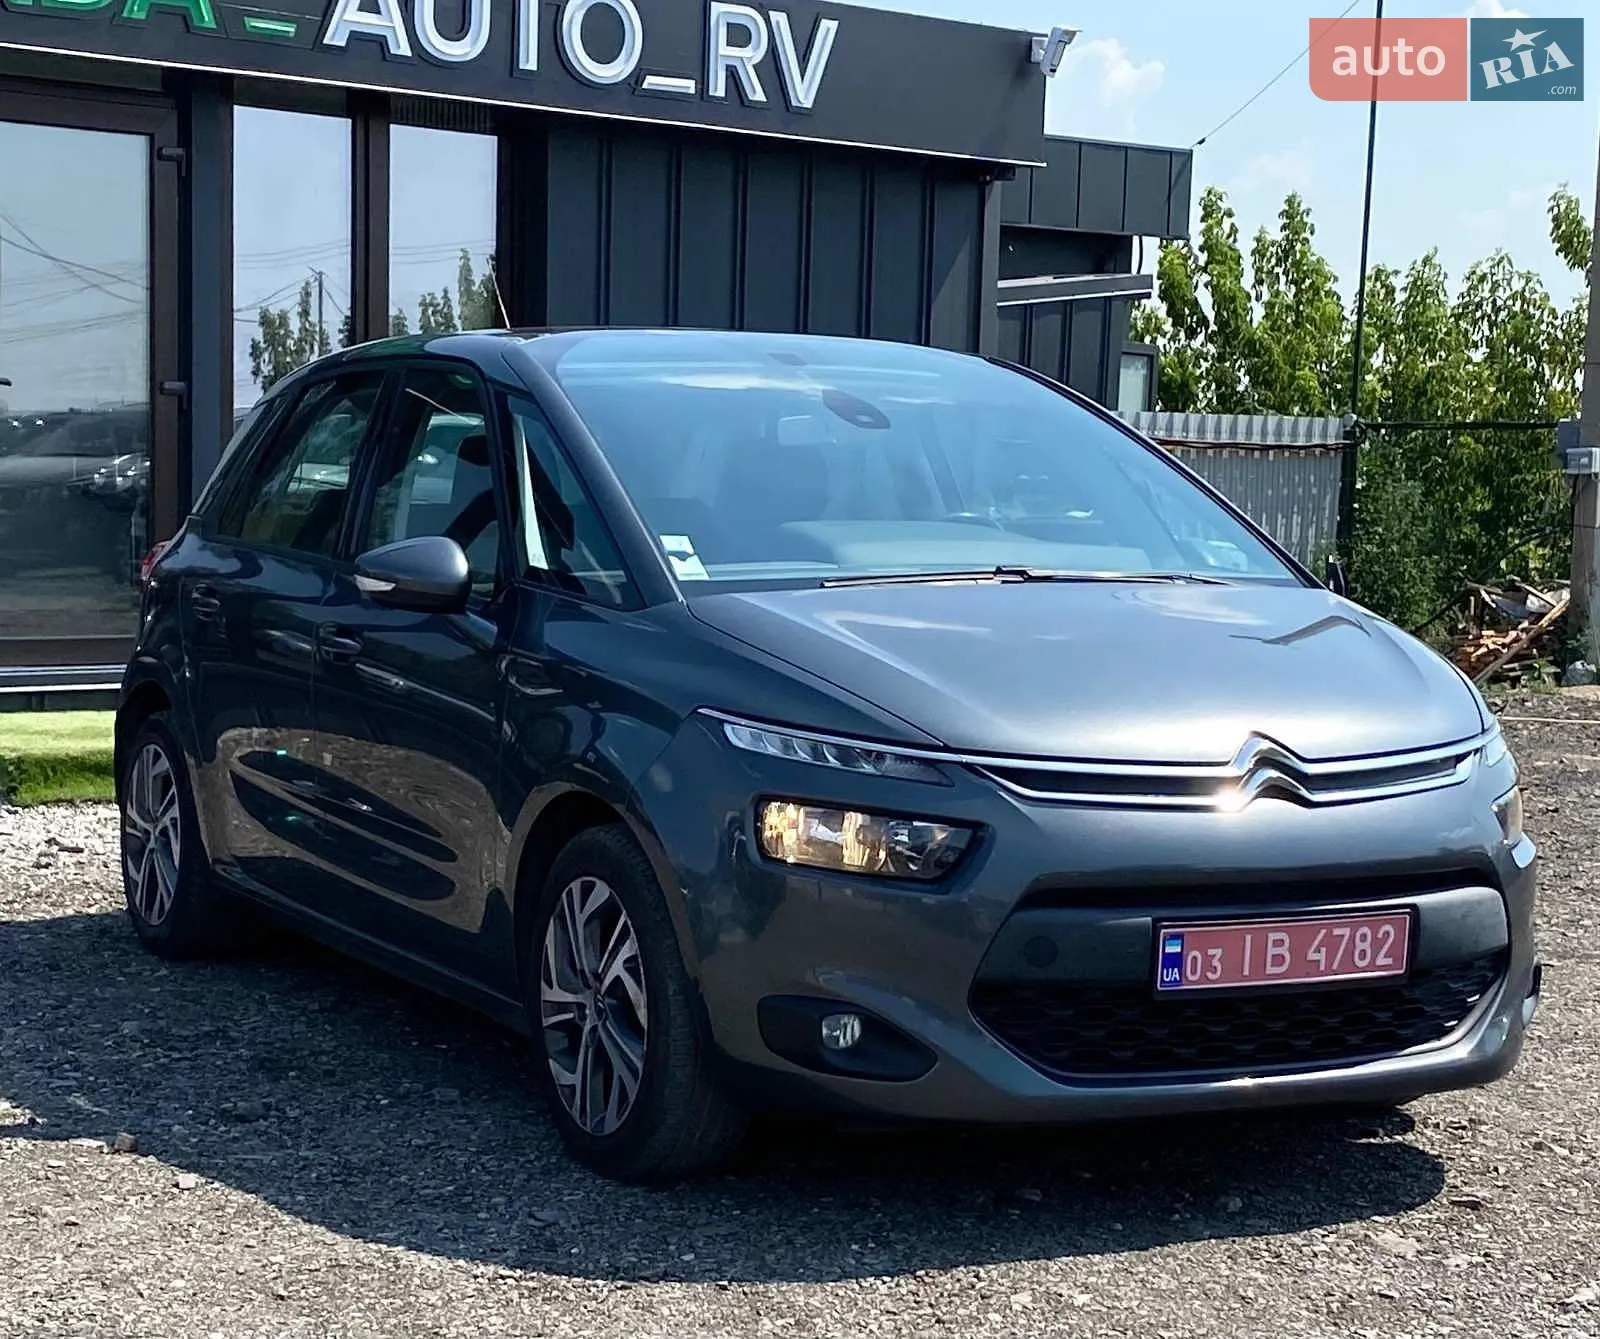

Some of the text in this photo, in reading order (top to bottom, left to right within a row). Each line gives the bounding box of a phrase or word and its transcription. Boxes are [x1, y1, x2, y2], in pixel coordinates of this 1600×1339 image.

[1185, 924, 1396, 981] 03 IB 4782
[1163, 967, 1180, 982] UA
